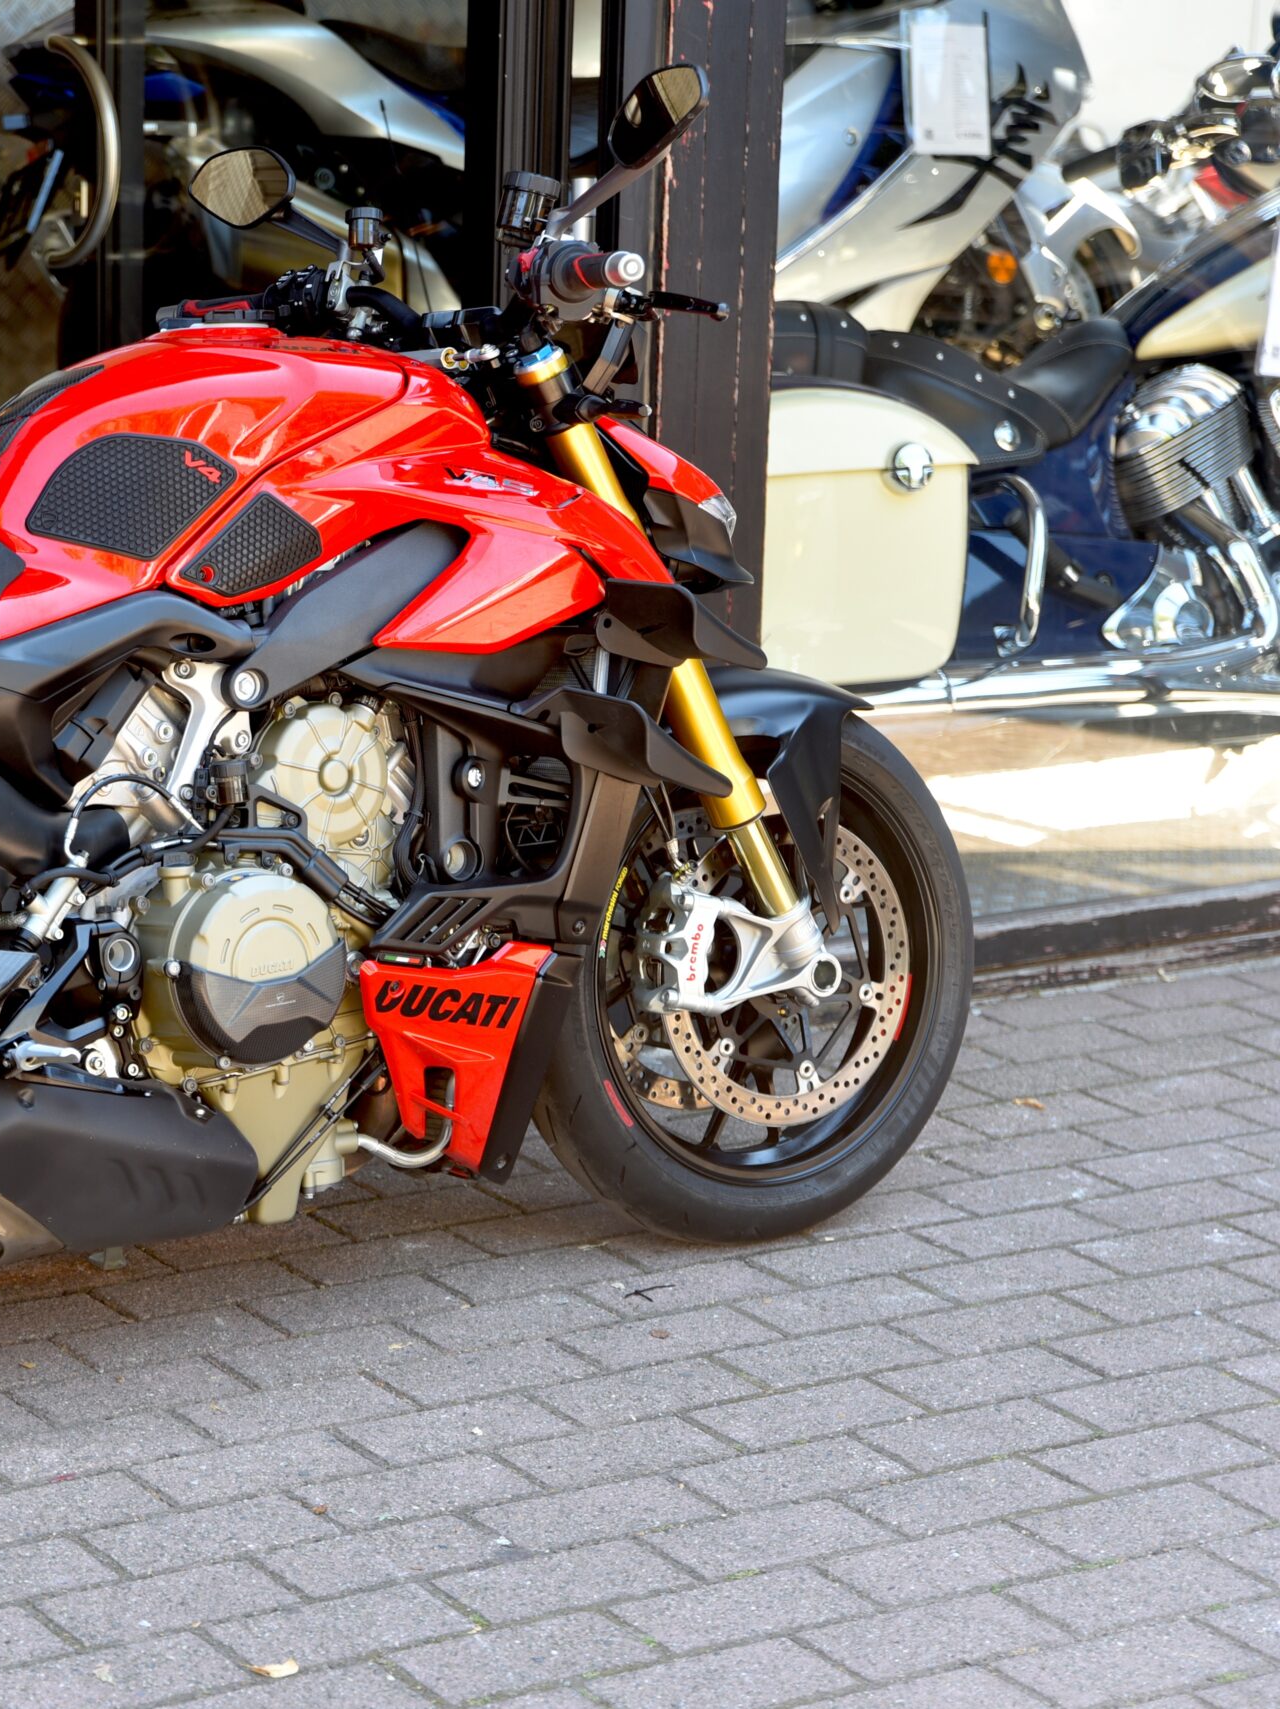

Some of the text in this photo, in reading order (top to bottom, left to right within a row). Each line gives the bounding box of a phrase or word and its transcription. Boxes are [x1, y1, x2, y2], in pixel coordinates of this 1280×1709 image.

[184, 449, 222, 484] V4
[251, 960, 296, 978] DUCATI
[687, 923, 704, 981] brembo
[374, 980, 521, 1029] DUCATI
